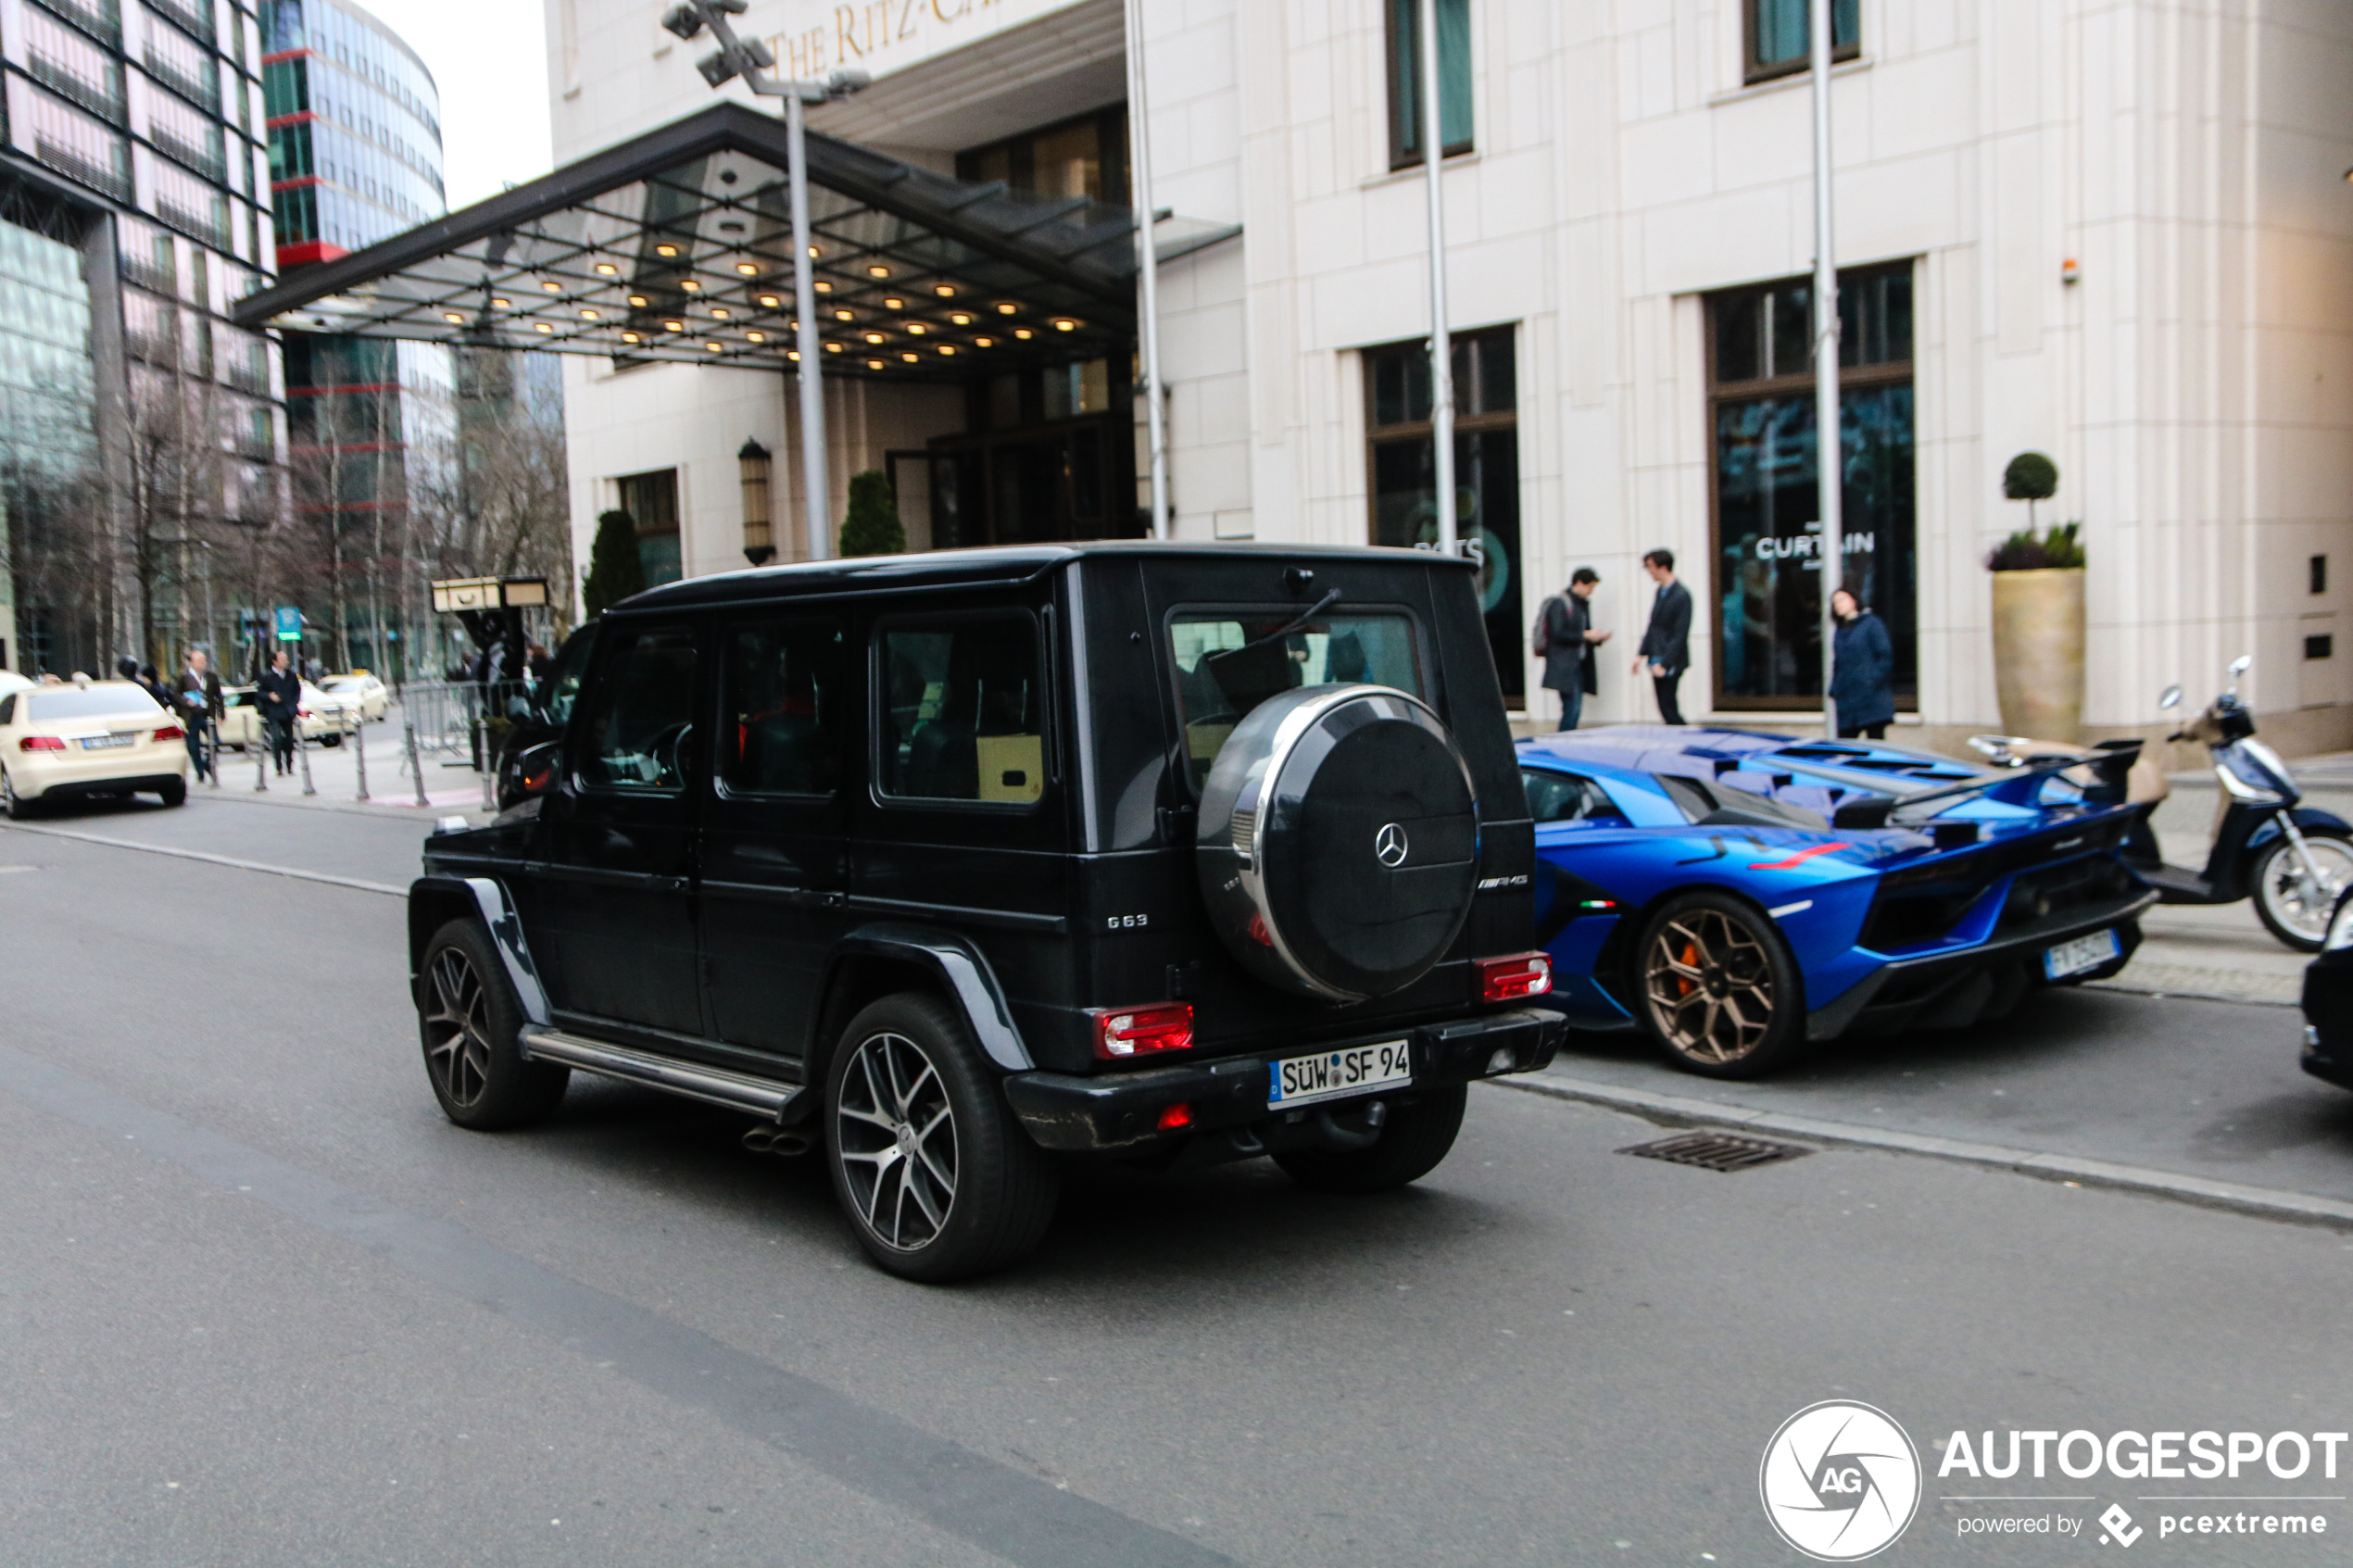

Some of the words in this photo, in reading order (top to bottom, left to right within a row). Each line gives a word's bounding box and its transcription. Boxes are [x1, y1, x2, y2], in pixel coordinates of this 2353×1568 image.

[764, 26, 827, 82] THE
[1755, 532, 1875, 559] CURTIN
[1282, 1057, 1328, 1095] SÜW
[1345, 1049, 1374, 1084] SF
[1380, 1044, 1408, 1077] 94
